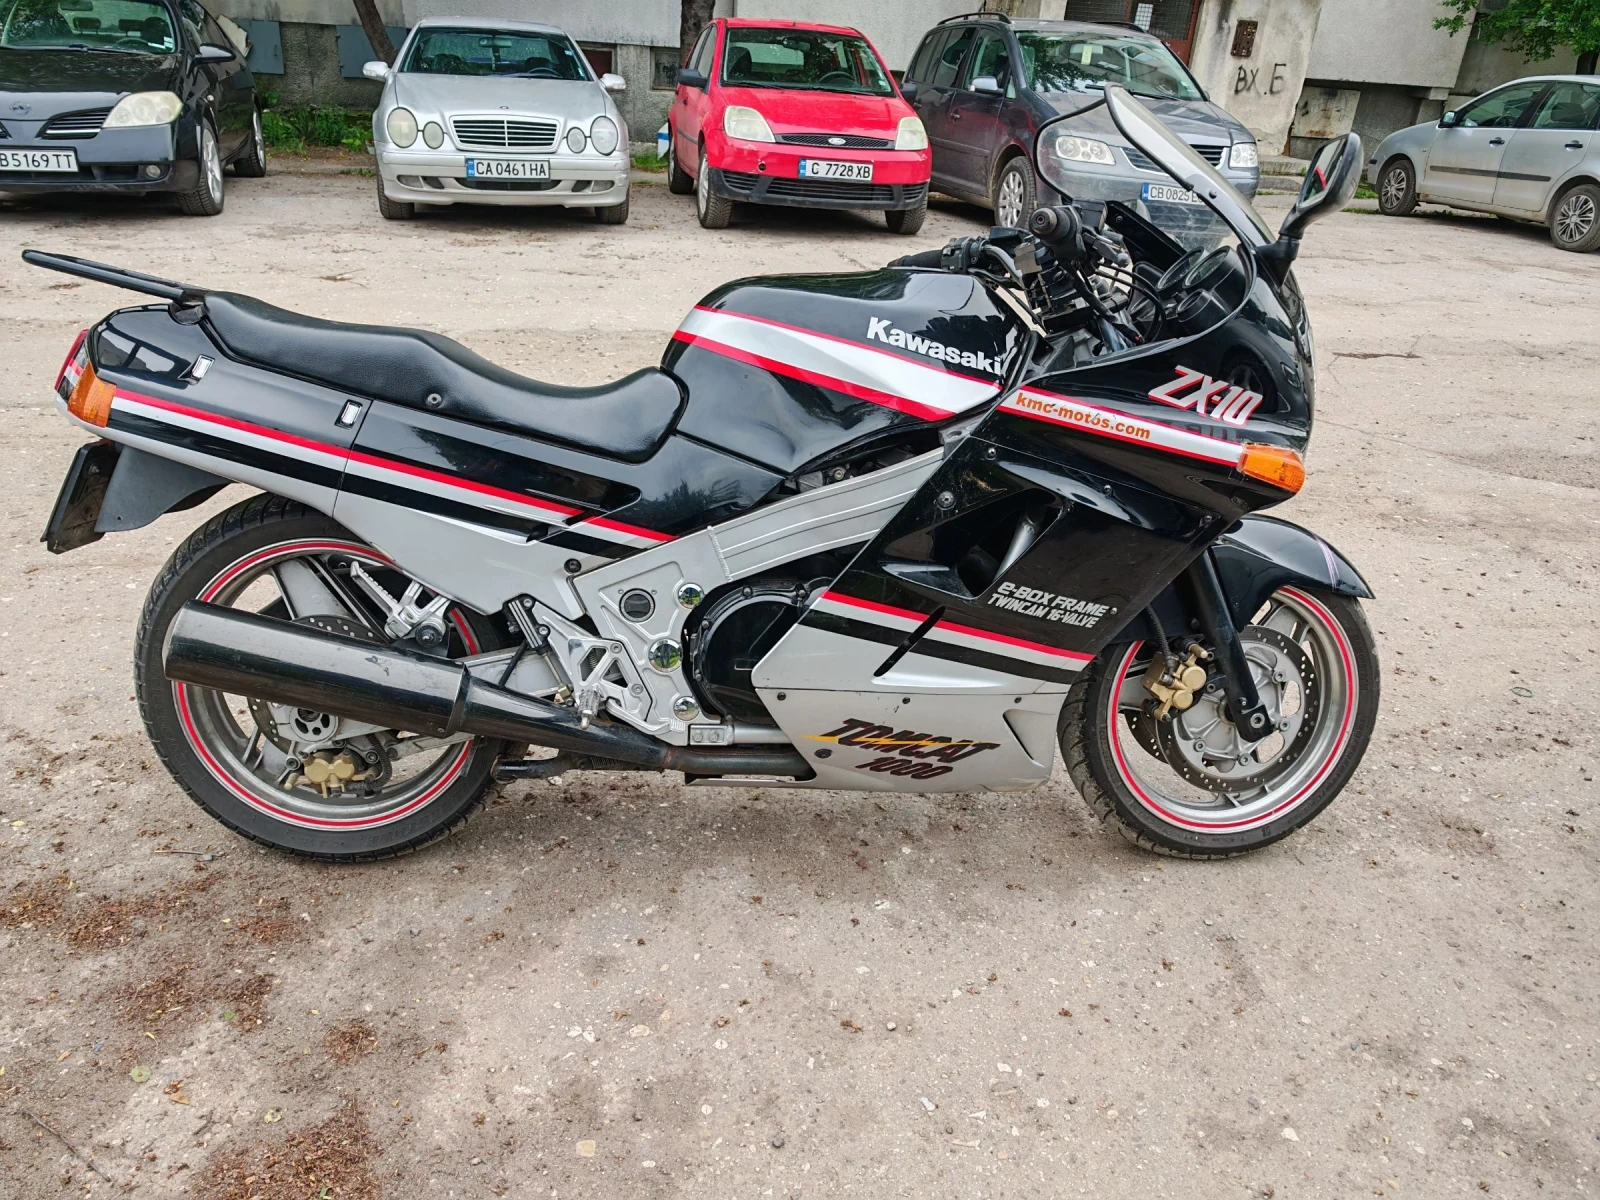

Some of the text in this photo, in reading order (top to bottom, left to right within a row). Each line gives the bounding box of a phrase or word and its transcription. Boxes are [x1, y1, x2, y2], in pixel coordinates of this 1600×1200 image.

[11, 153, 49, 168] 5169
[52, 154, 72, 168] TT
[476, 162, 493, 175] CA
[496, 162, 526, 176] 0461
[530, 163, 547, 176] HA
[811, 162, 820, 175] C
[825, 163, 854, 177] 7728
[855, 166, 871, 178] XB
[1150, 186, 1164, 199] CB
[1166, 188, 1190, 201] 0825
[866, 316, 1002, 375] Kawasaki
[1148, 364, 1263, 427] ZX-10
[1016, 392, 1151, 439] kmc-motos.com
[987, 593, 1100, 628] TWINCAM 16-VALVE
[1051, 595, 1110, 617] FRAME
[819, 718, 1001, 763] TOMCAT
[855, 756, 953, 779] 1000
